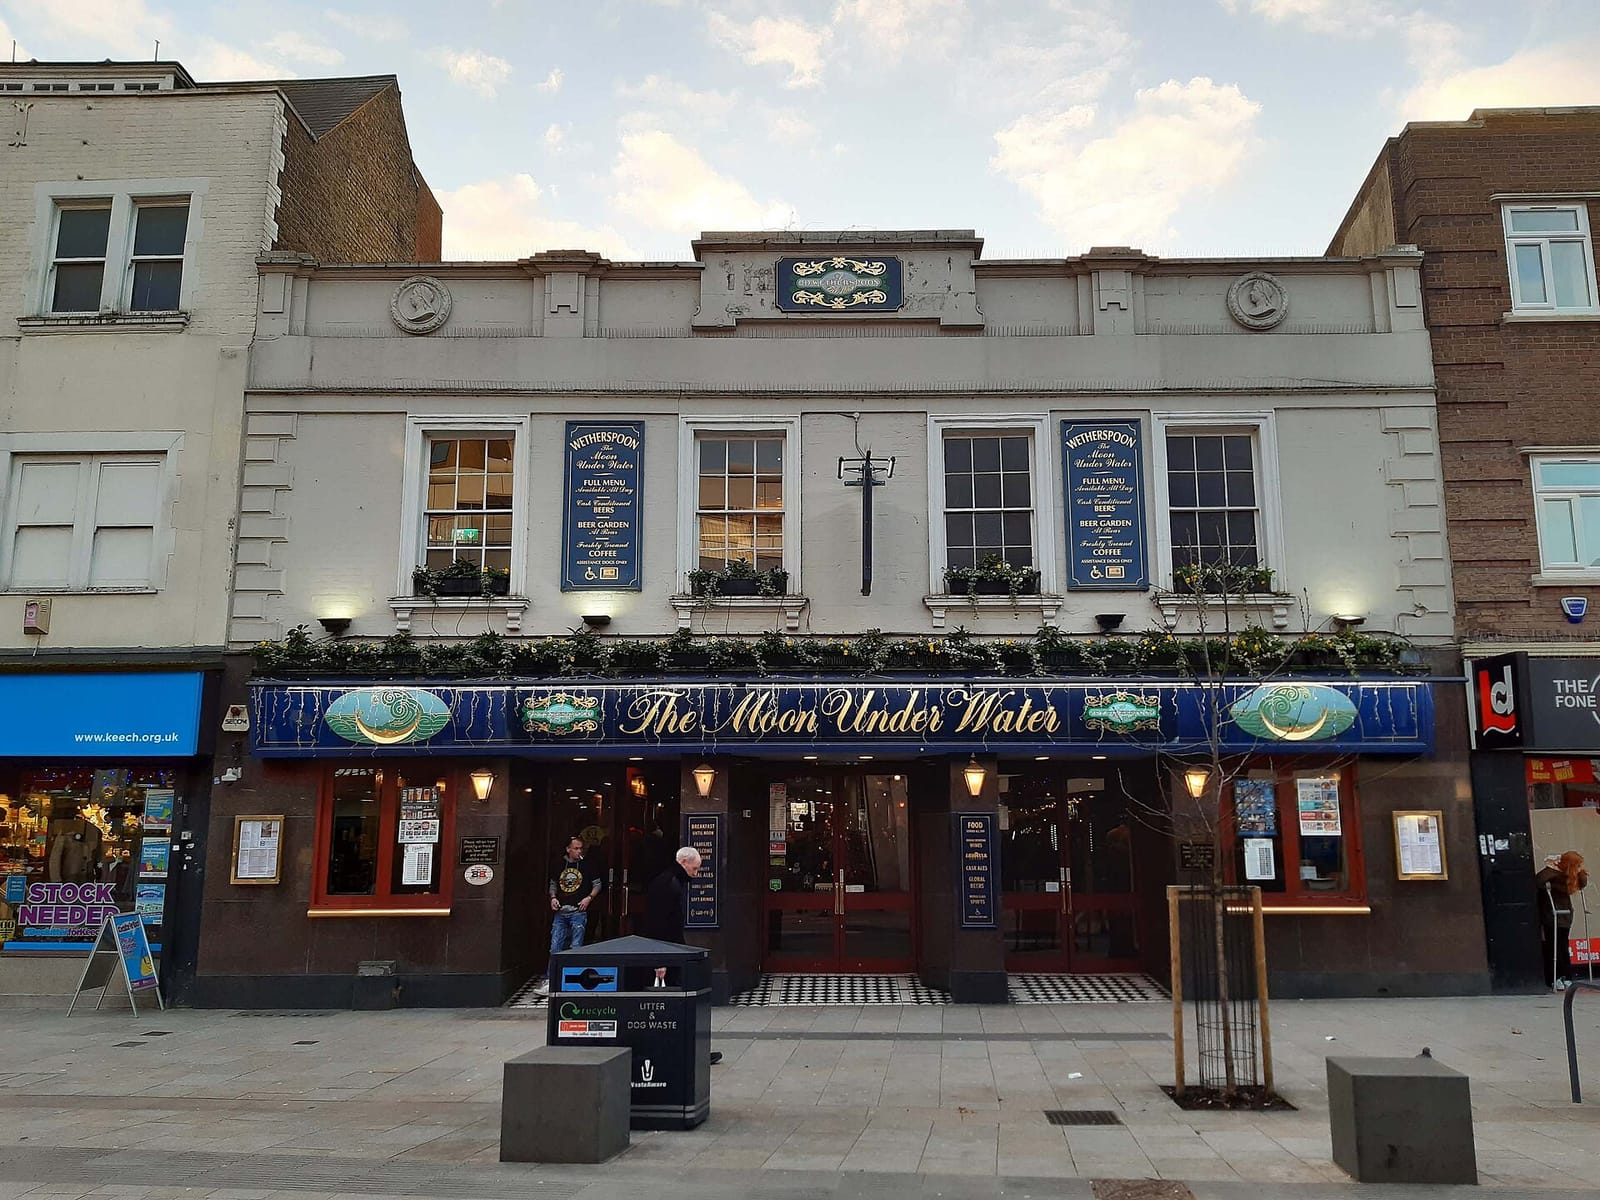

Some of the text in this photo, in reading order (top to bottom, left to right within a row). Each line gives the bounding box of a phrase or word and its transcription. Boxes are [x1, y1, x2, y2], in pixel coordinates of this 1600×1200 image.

[569, 431, 640, 451] WETHERSPOON
[1065, 429, 1136, 450] WETHERSPOON
[590, 451, 618, 460] Moon
[1087, 450, 1115, 458] Moon
[576, 460, 634, 470] Under Water
[1074, 459, 1132, 468] Under Water
[576, 541, 602, 550] Freshly
[1079, 540, 1105, 548] Freshly
[1552, 680, 1588, 693] THE
[1555, 695, 1597, 708] FONE
[619, 688, 1062, 734] The Moon Under Water
[74, 732, 179, 744] www.keech.org.uk
[28, 882, 117, 904] STOCK
[1576, 940, 1588, 950] Sell
[640, 1002, 665, 1011] LITTER
[649, 1012, 656, 1020] &
[627, 1021, 677, 1030] DOG WASTE
